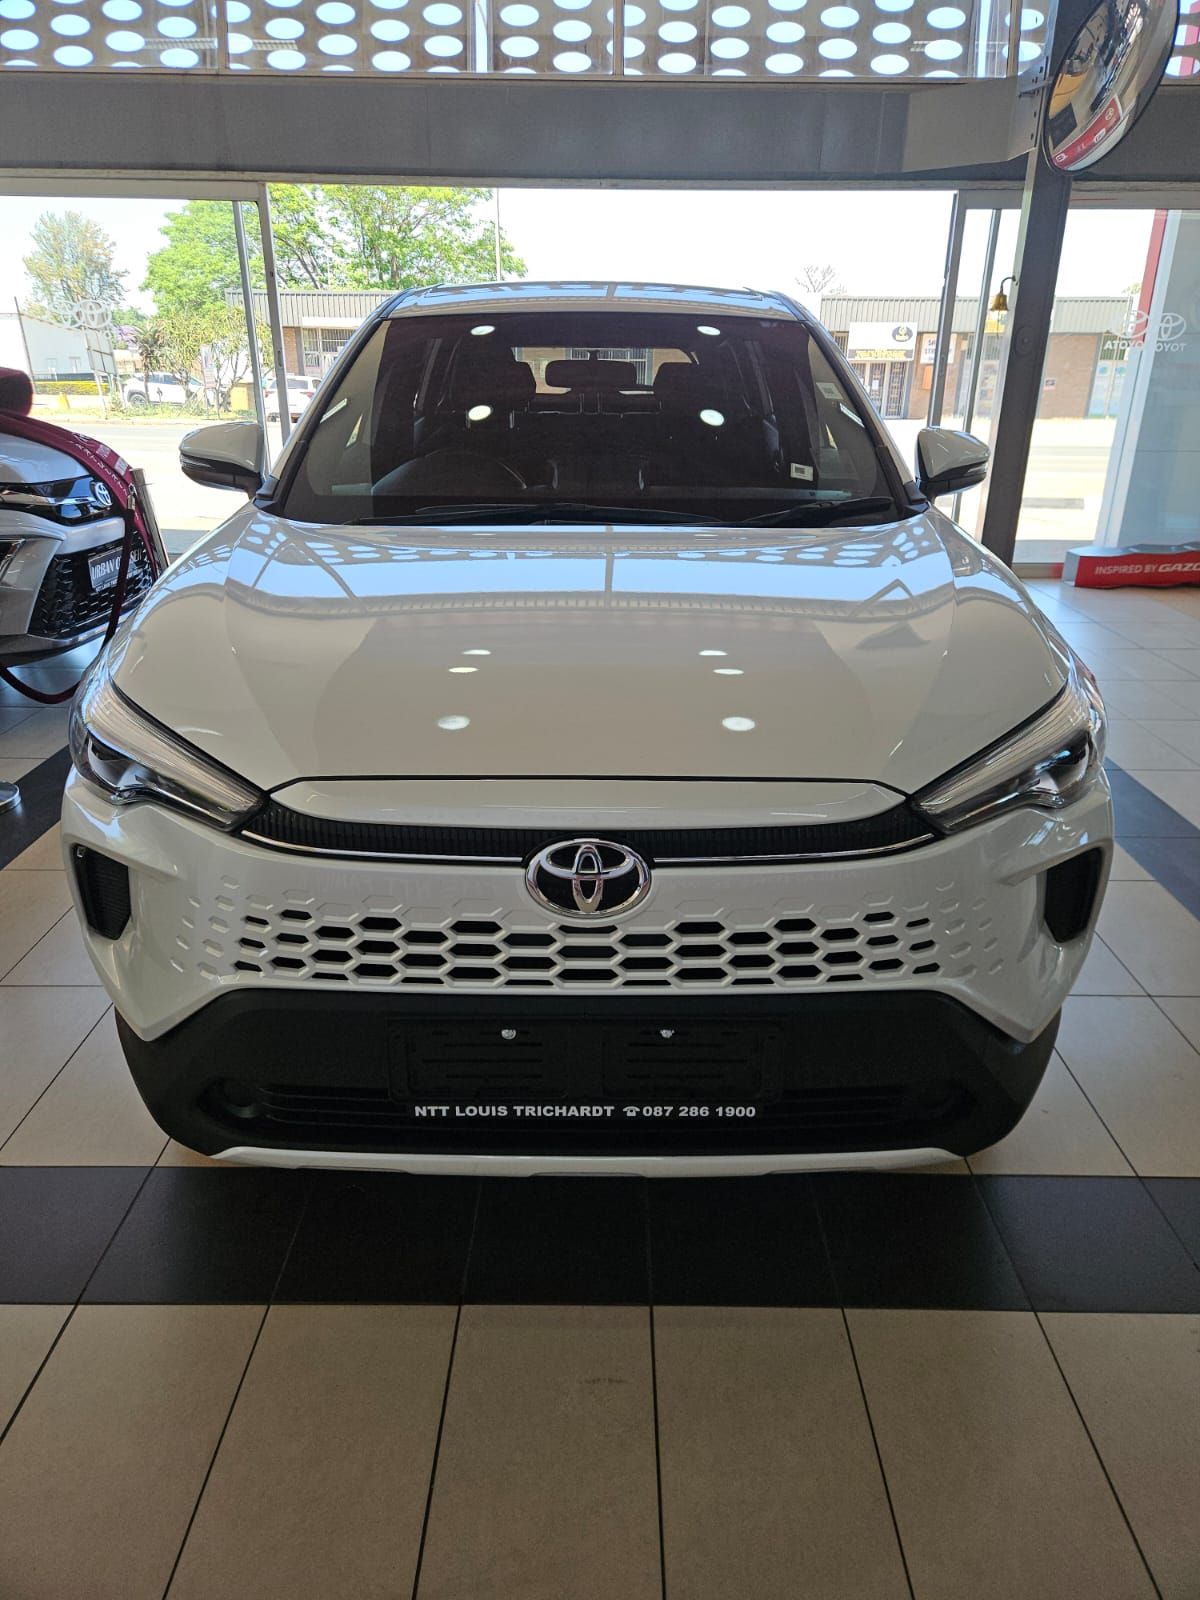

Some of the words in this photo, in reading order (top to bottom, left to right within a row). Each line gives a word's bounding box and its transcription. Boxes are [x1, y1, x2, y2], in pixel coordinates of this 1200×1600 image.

[1095, 565, 1142, 575] INSPIRED
[1144, 564, 1158, 573] BY
[414, 1105, 450, 1117] NTT
[455, 1105, 509, 1117] LOUIS
[513, 1105, 615, 1117] TRICHARDT
[642, 1105, 674, 1117] 087
[678, 1105, 710, 1117] 286
[715, 1105, 756, 1117] 1900
